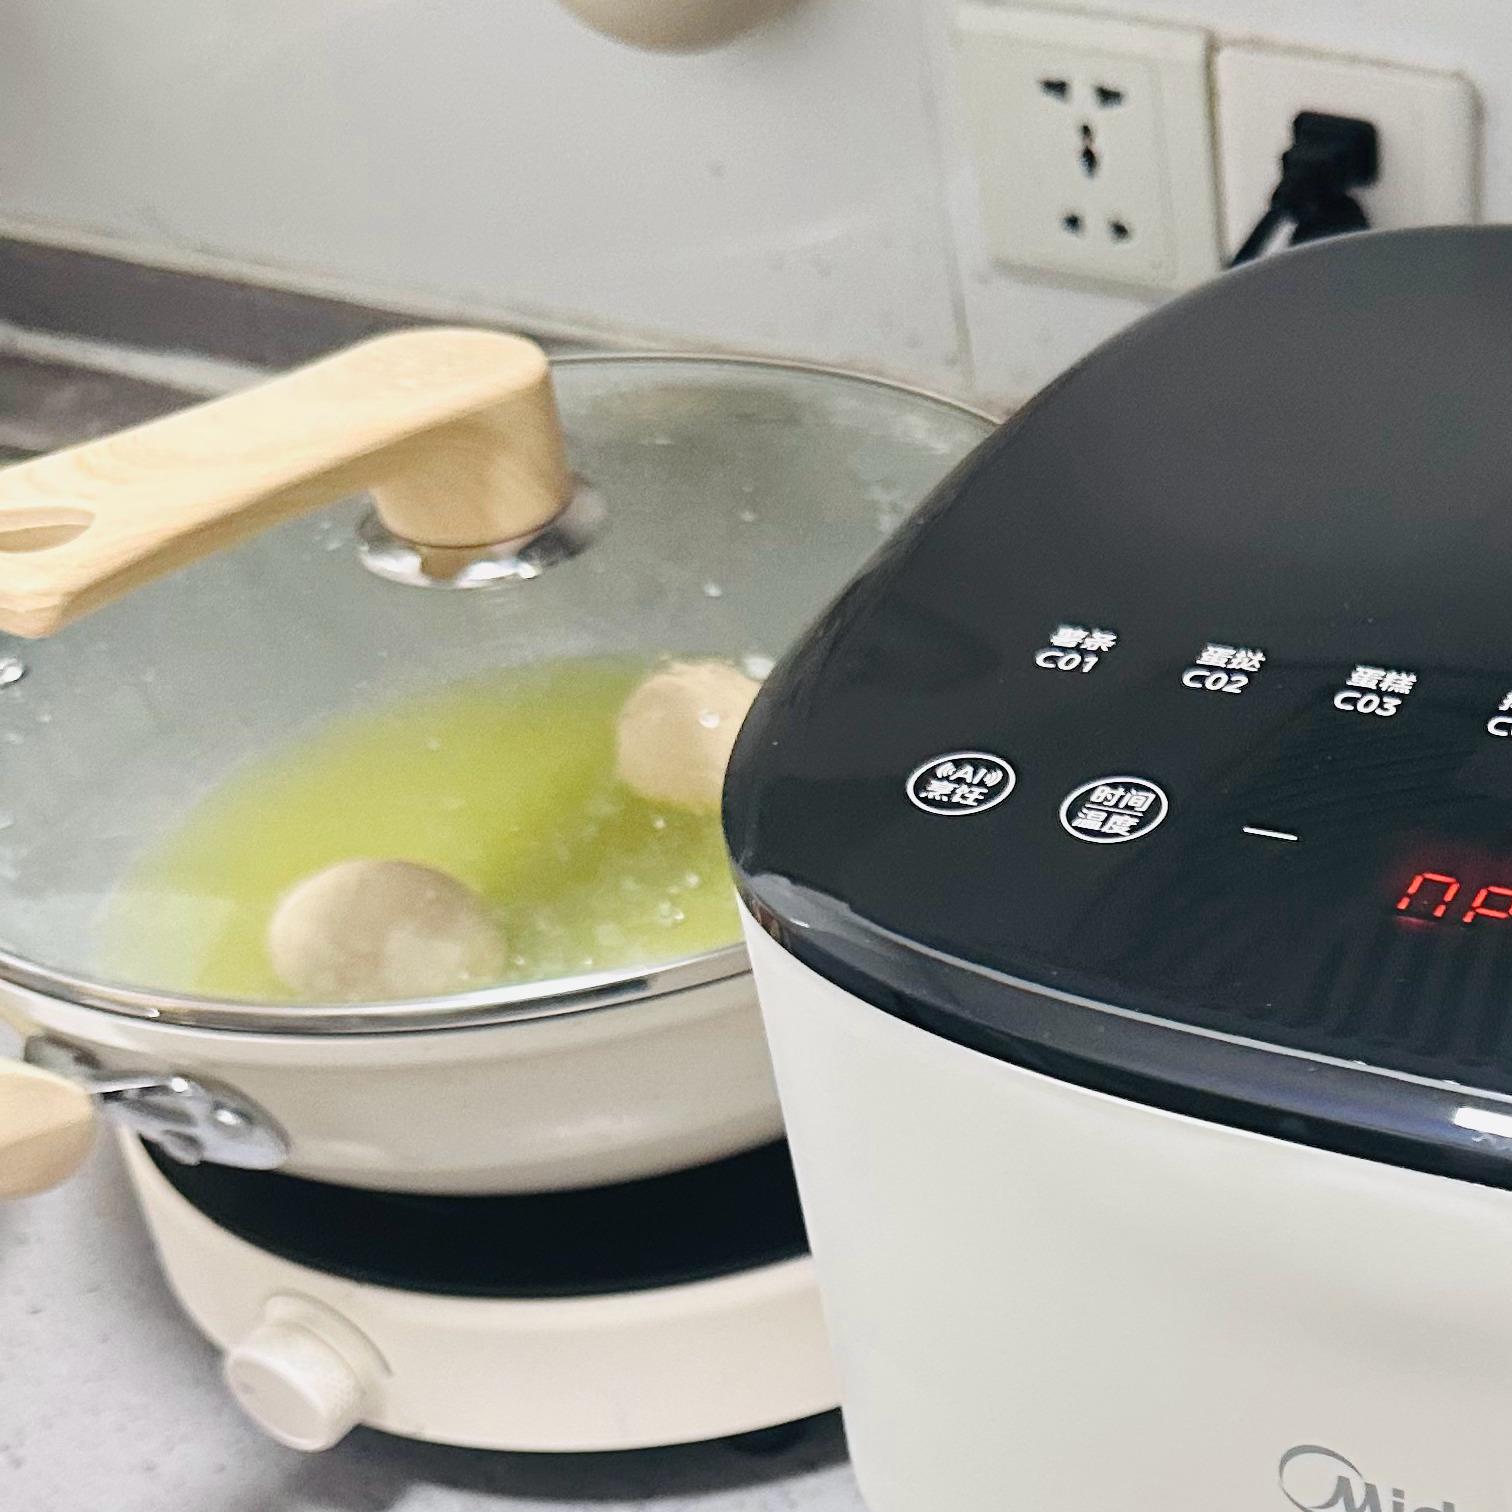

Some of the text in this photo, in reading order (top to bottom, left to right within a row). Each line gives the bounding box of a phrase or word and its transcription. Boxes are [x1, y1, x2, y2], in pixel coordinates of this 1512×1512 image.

[1035, 647, 1099, 673] C01
[1181, 667, 1249, 694] C02
[1346, 664, 1417, 695] 蛋糕
[1333, 690, 1402, 717] C03
[1089, 784, 1157, 812] 时间
[1071, 806, 1141, 837] 温度
